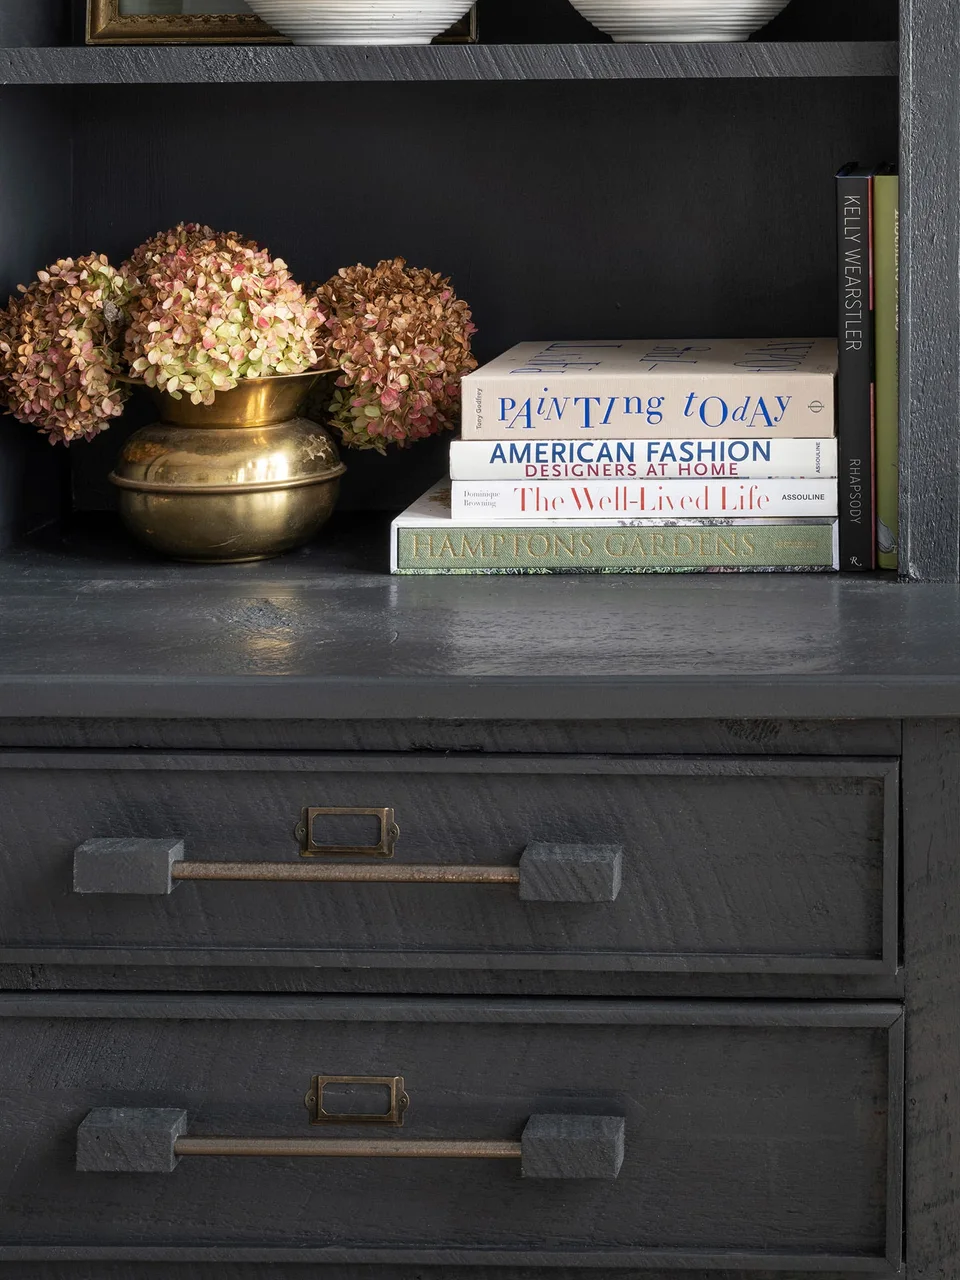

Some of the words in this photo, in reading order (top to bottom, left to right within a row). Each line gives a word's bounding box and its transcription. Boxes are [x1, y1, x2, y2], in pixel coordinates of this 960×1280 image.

[844, 195, 861, 245] KELLY
[845, 248, 862, 352] WEARSTLER
[475, 388, 483, 414] Godfrey
[475, 415, 483, 430] Tony
[489, 442, 635, 464] AMERICAN
[647, 440, 771, 463] FASHION
[525, 463, 637, 477] DESIGNERS
[646, 463, 667, 477] AT
[678, 462, 738, 477] HOME
[464, 490, 501, 499] Dominique
[464, 499, 497, 507] Browning
[514, 487, 564, 512] The
[570, 486, 709, 512] Well-Lived
[721, 485, 770, 512] Life
[781, 493, 825, 501] ASSOULINE
[849, 458, 862, 525] RHAPSODY
[412, 533, 601, 559] HAMPTONS
[605, 530, 755, 557] GARDENS
